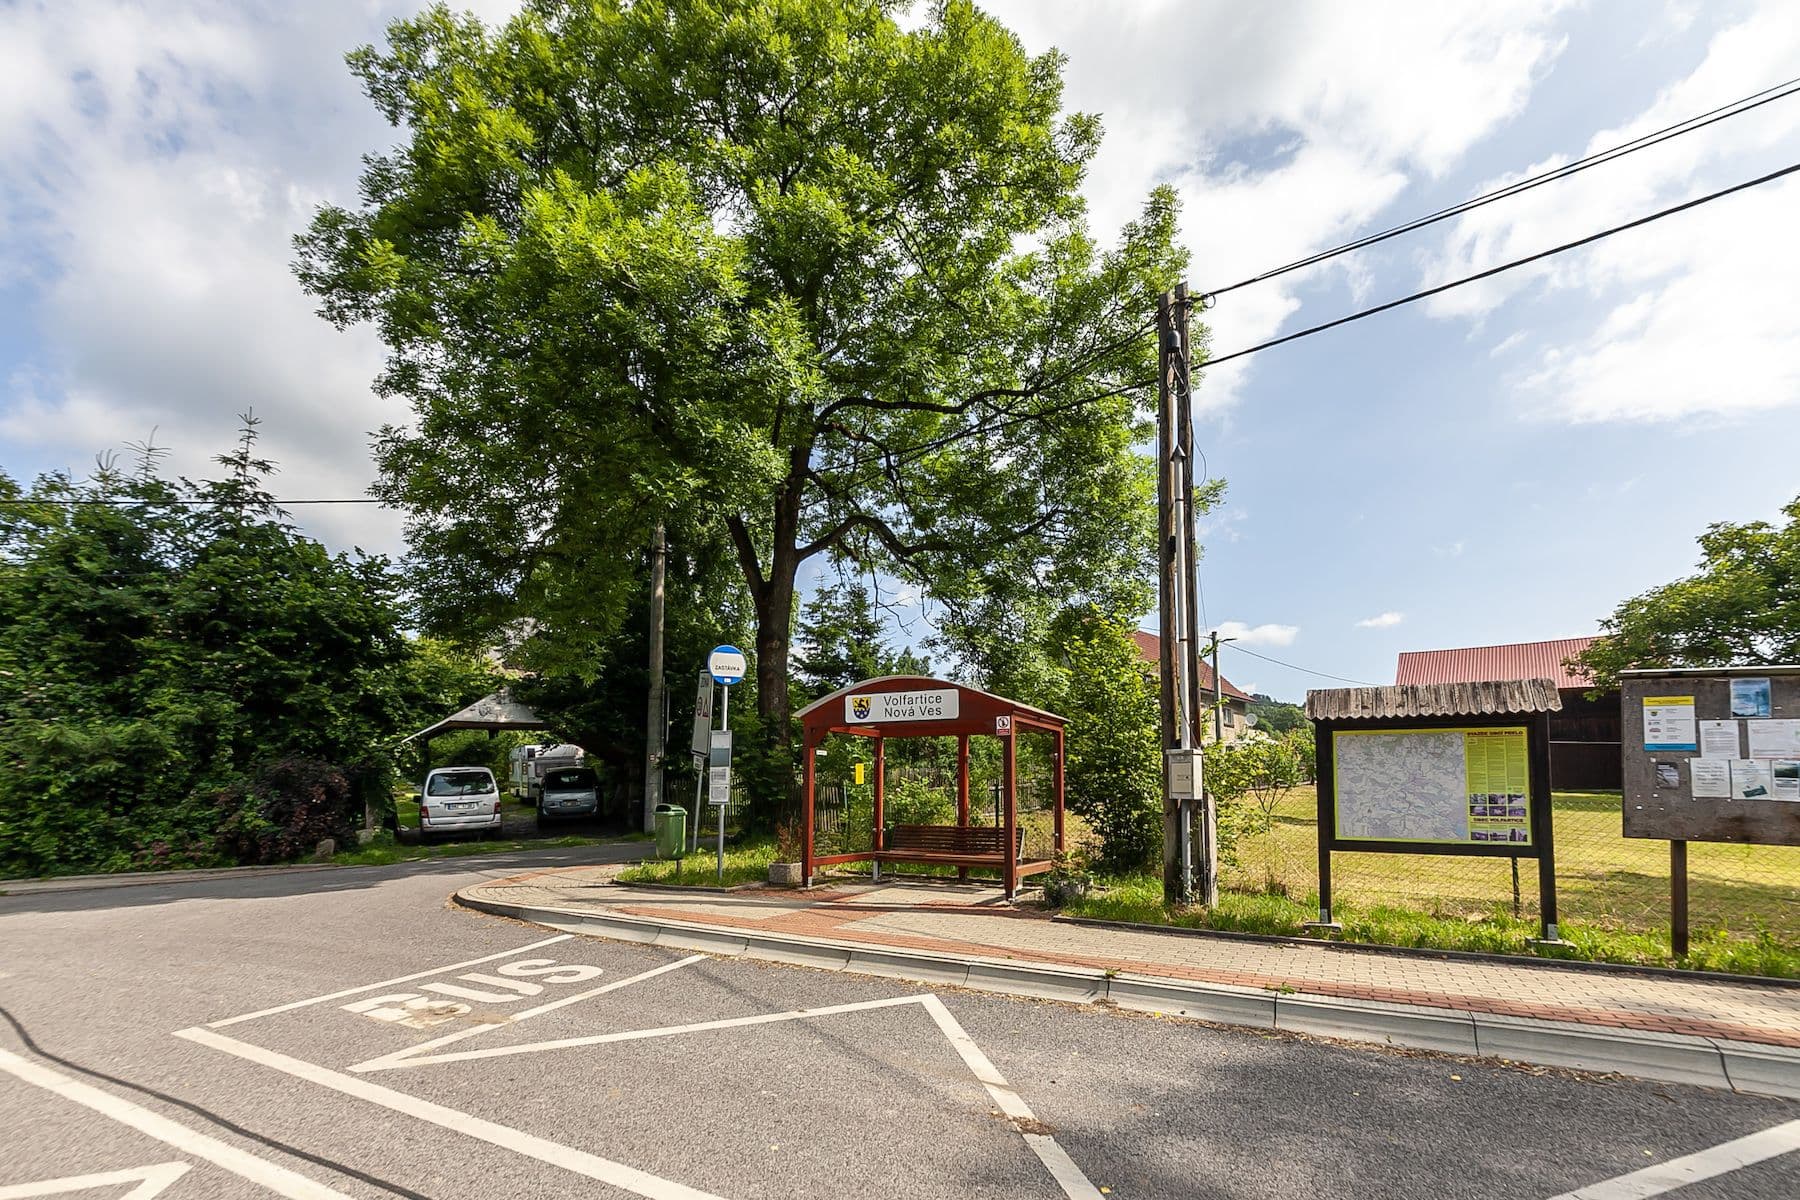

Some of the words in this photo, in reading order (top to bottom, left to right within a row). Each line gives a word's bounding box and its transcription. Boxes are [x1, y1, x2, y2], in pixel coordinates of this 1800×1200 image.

[883, 694, 942, 706] Volfartice
[884, 706, 915, 718] Nová
[919, 705, 942, 716] Ves
[338, 959, 603, 1029] BUS
